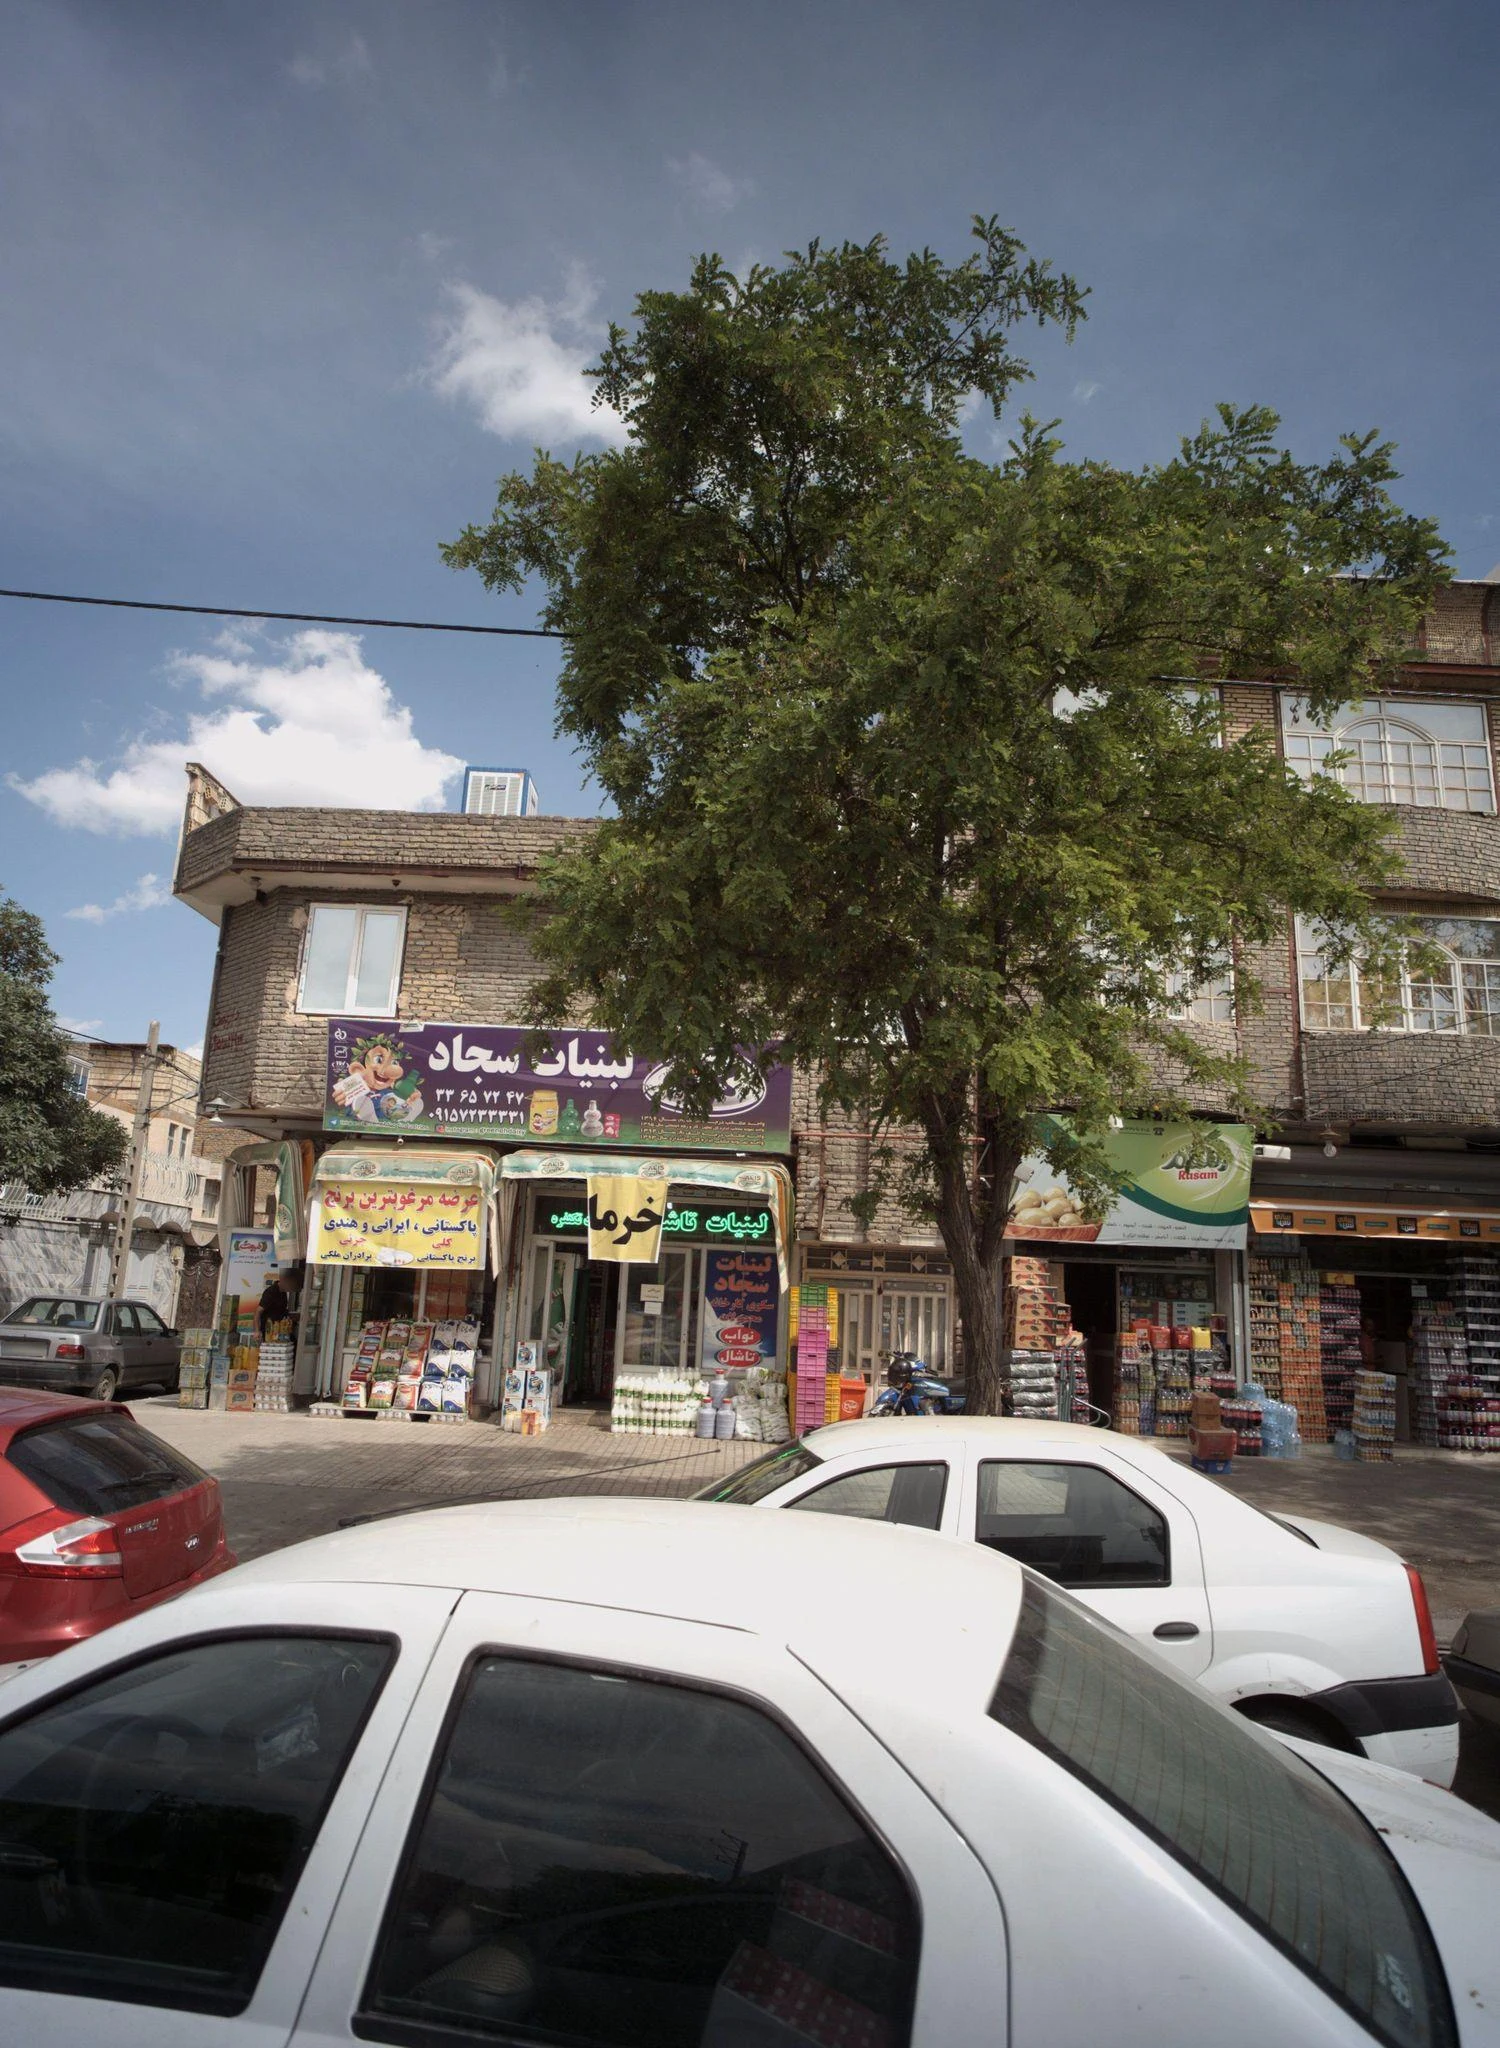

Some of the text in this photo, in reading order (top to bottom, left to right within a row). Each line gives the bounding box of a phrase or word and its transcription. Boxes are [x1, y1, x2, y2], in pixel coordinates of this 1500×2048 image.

[429, 1033, 519, 1084] سجاد
[436, 1088, 524, 1106] ۳۳ ۶۵ ۷۲ ۴۷
[1178, 1170, 1218, 1180] Rasam
[324, 1185, 479, 1213] عرضه مرغوبترین برنج
[324, 1219, 358, 1231] هندی
[372, 1218, 410, 1234] ایرانی
[589, 1193, 663, 1245] خرما
[706, 1211, 769, 1238] لبنیات
[362, 1222, 368, 1233] و
[422, 1219, 477, 1238] پاکستانی
[432, 1237, 452, 1249] کلی
[320, 1250, 341, 1259] ملکی
[343, 1252, 372, 1262] برادران
[457, 1254, 476, 1264] برنج
[716, 1254, 771, 1276] لبنیات
[714, 1273, 769, 1297] سجاد
[725, 1329, 754, 1343] نواب
[721, 1349, 756, 1363] تاشال
